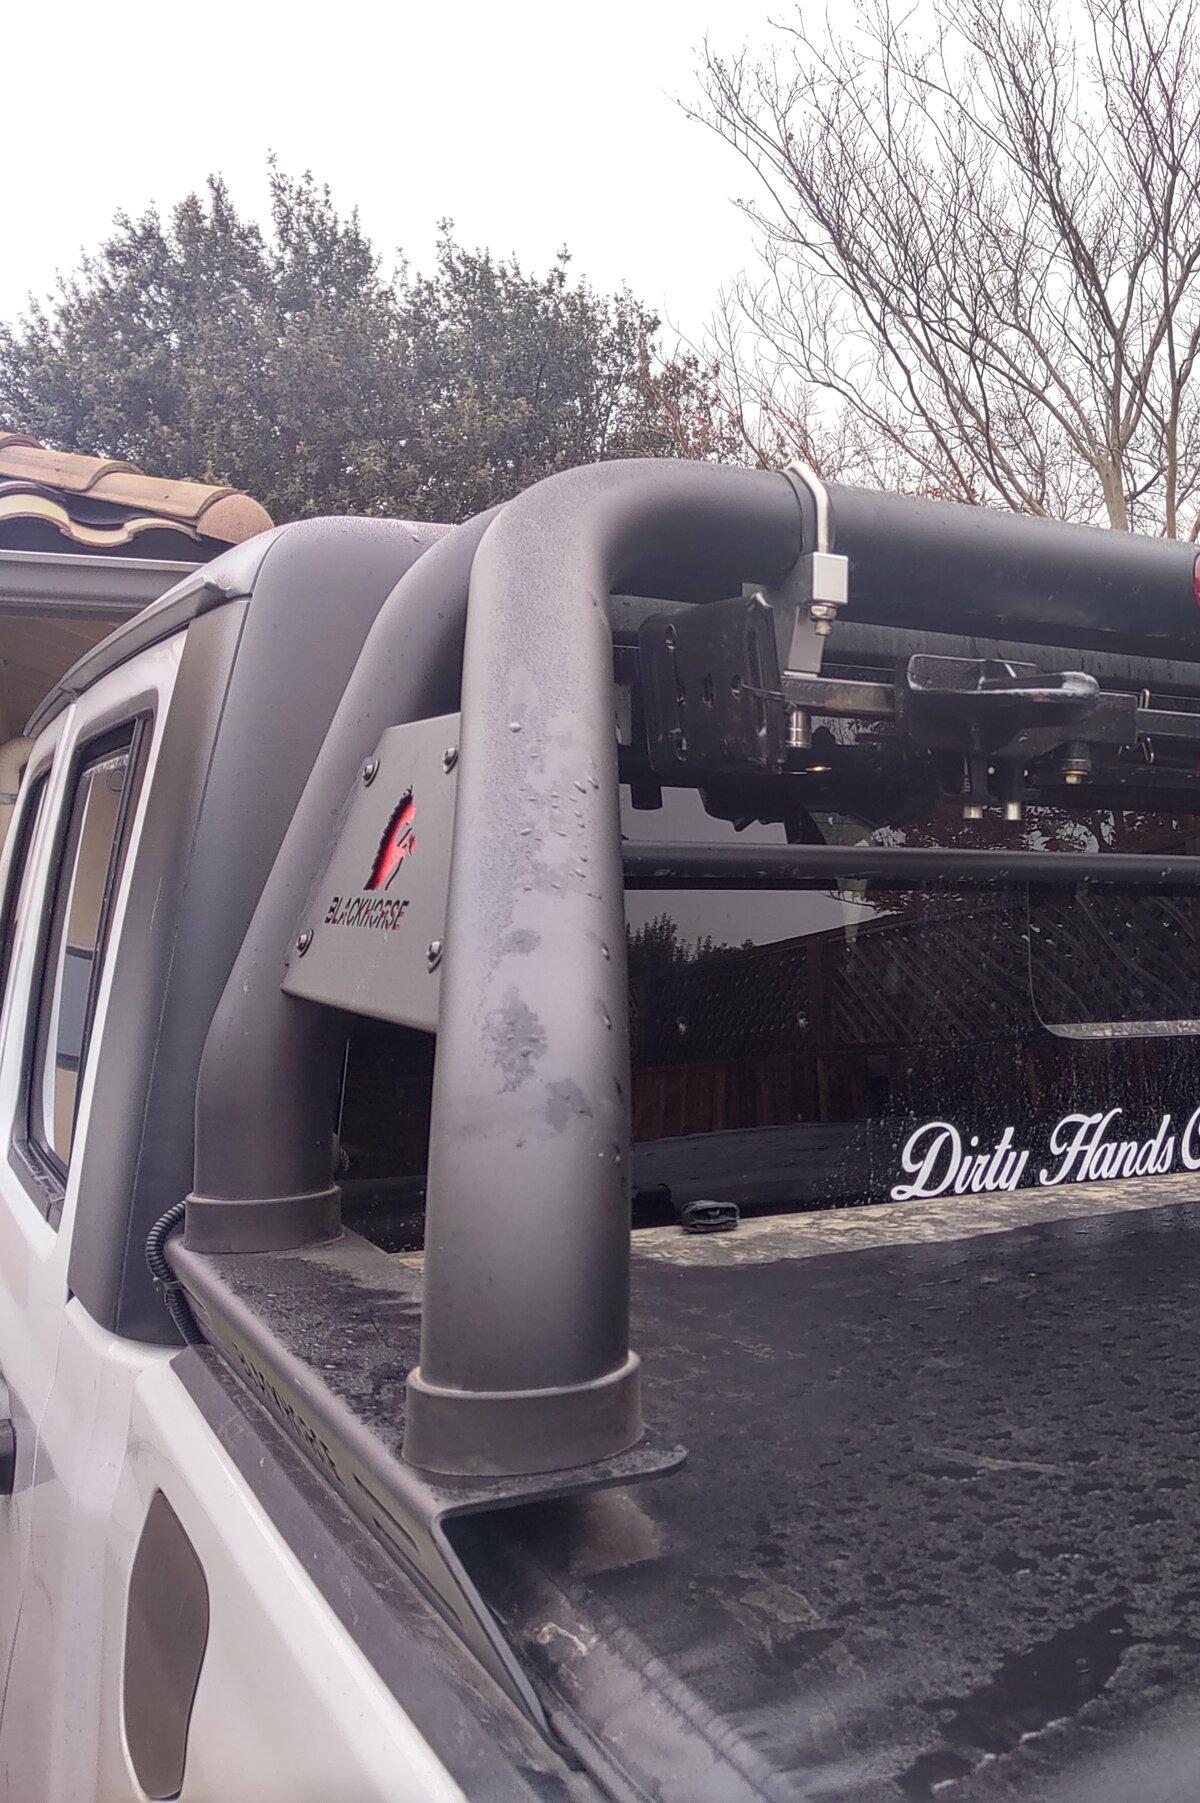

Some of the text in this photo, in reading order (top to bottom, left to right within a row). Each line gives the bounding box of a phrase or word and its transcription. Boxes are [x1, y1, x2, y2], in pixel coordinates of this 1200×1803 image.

[324, 896, 410, 930] BLACKHORSE
[890, 1121, 1029, 1200] Dirty
[1039, 1107, 1175, 1185] Hands
